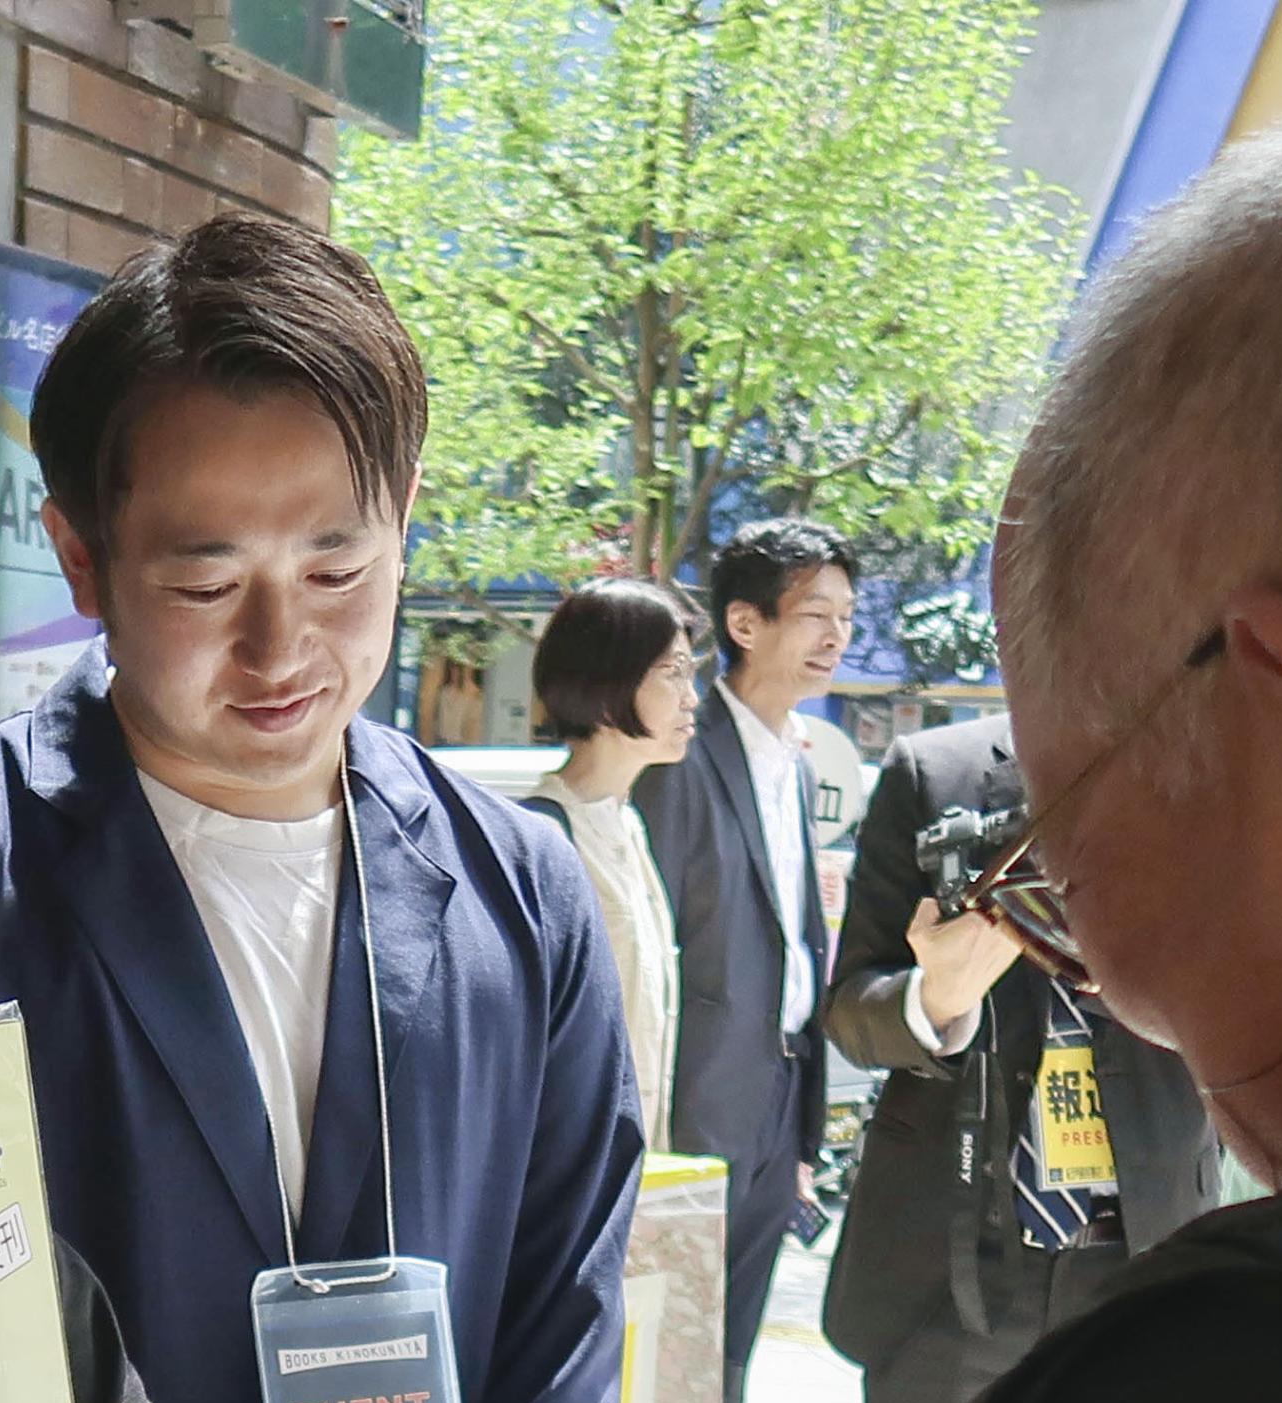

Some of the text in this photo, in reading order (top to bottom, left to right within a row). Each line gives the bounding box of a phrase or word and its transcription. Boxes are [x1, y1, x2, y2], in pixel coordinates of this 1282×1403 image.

[961, 1133, 974, 1185] SONY
[284, 1340, 423, 1370] BOOKS KINOKUNIYA
